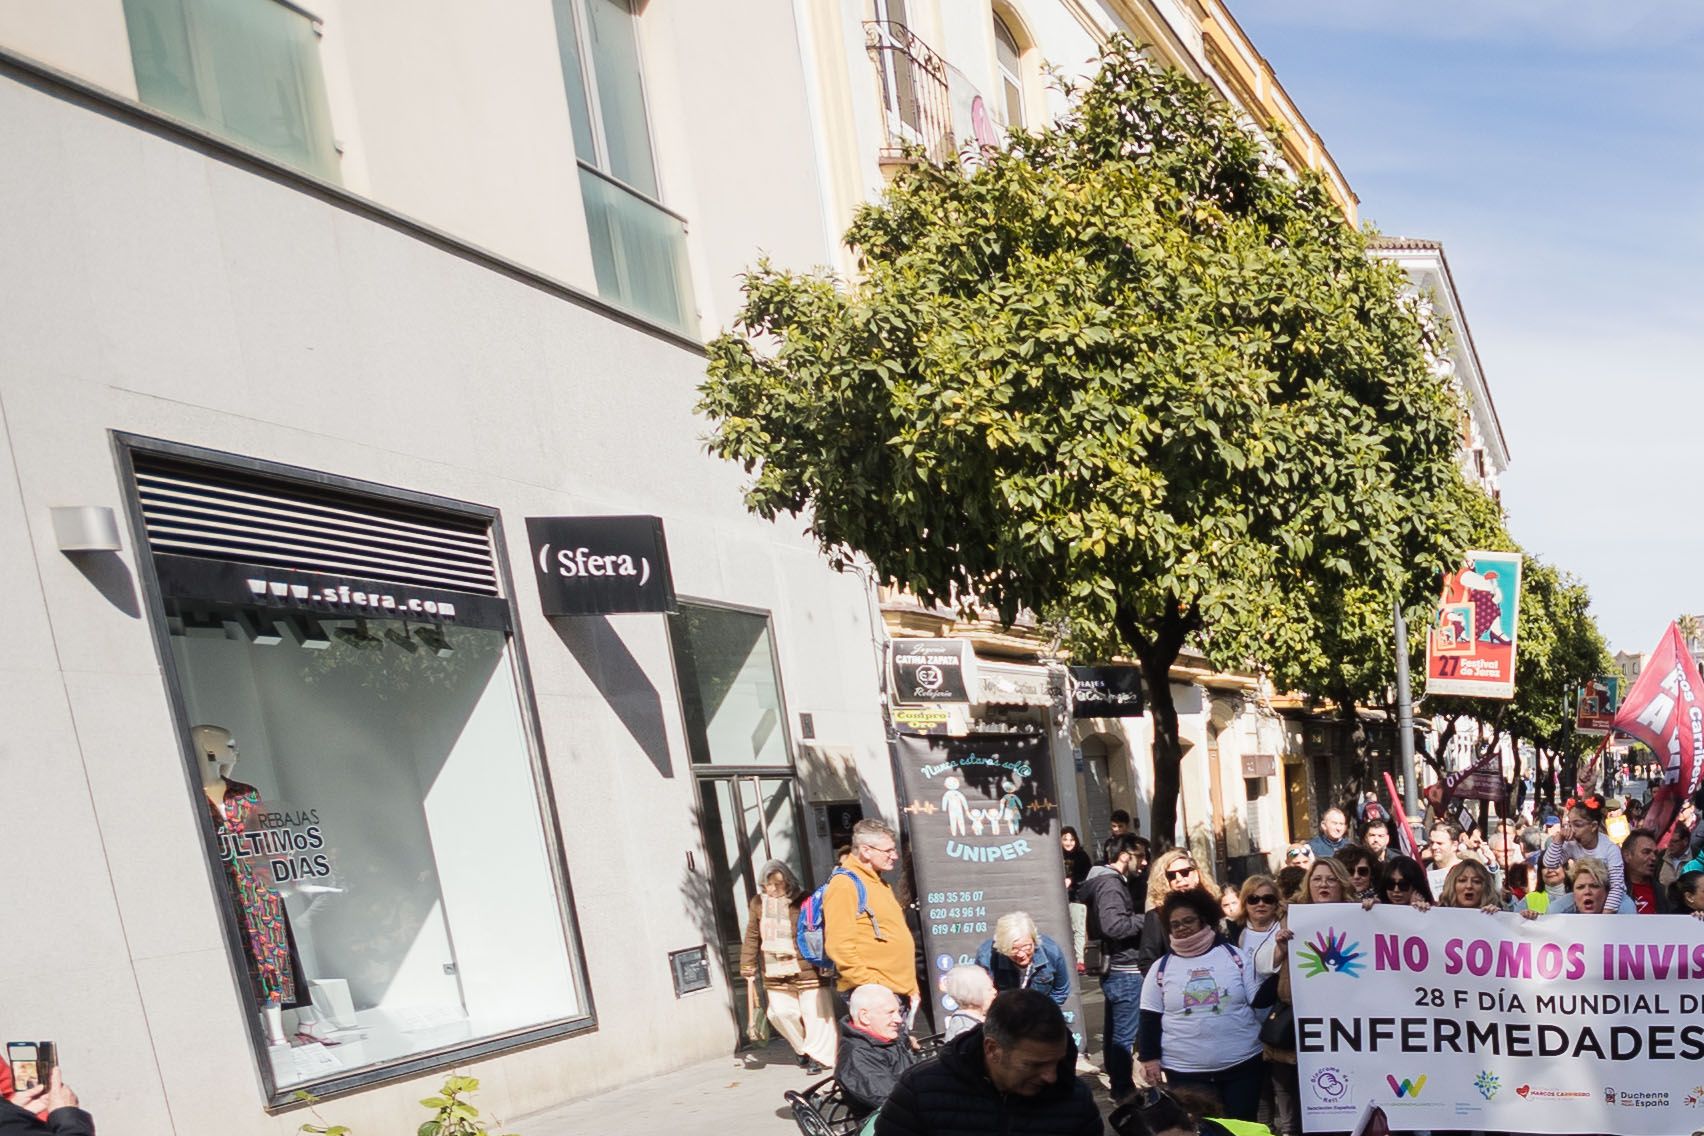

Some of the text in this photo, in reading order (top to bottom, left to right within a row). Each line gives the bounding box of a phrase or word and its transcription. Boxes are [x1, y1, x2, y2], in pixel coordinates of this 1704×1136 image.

[246, 578, 455, 616] www.sfera.com
[896, 655, 959, 666] CATINA ZAPATA
[1438, 655, 1460, 677] 27
[1461, 657, 1499, 669] Festival
[1460, 667, 1475, 676] de
[897, 711, 946, 721] Compro
[258, 809, 320, 828] REBAJAS
[946, 838, 1032, 863] UNIPER
[271, 850, 331, 882] DÍAS
[928, 891, 984, 904] 689 35 26 07
[930, 906, 986, 919] 620 43 96 14
[932, 922, 987, 935] 619 47 67 03
[1374, 934, 1429, 972] NO
[1445, 938, 1586, 980] SOMOS
[1415, 987, 1445, 1007] 28
[1454, 990, 1468, 1008] F
[1478, 987, 1527, 1013] DÍA
[1536, 994, 1669, 1015] MUNDIAL
[1620, 1091, 1669, 1099] Duchenne
[1635, 1098, 1669, 1107] España
